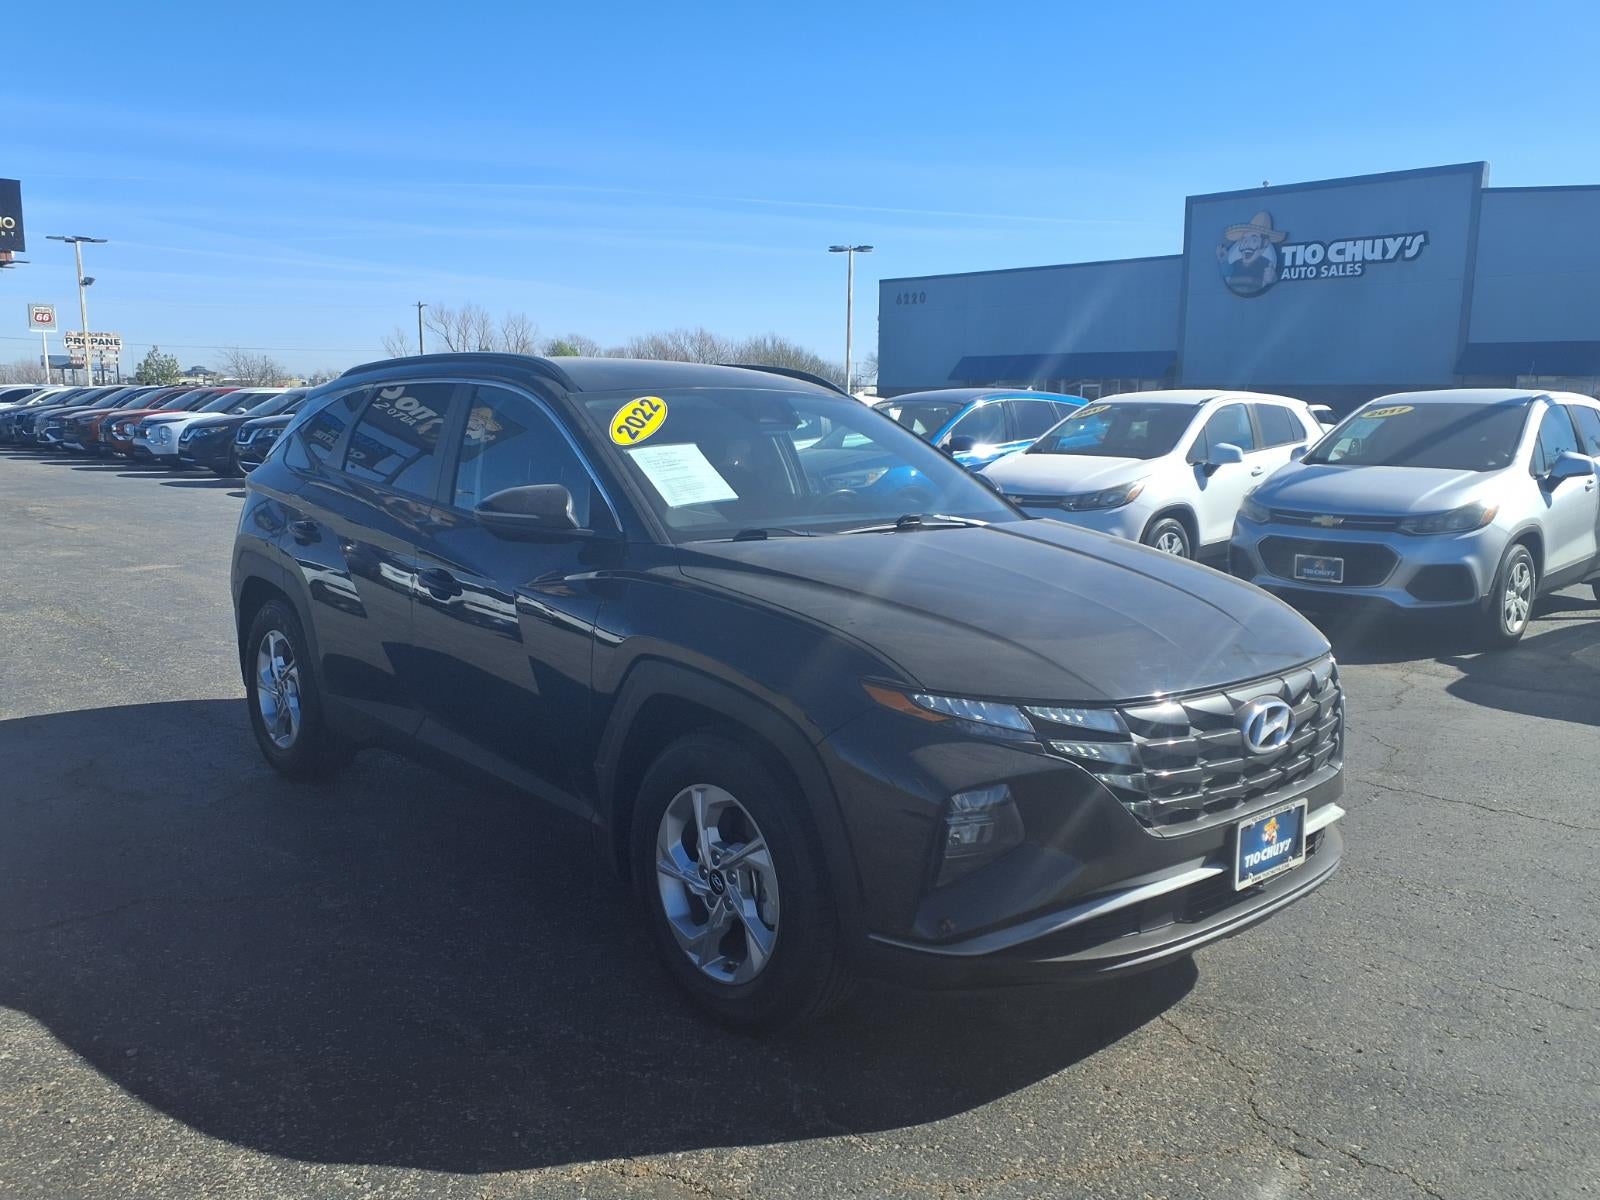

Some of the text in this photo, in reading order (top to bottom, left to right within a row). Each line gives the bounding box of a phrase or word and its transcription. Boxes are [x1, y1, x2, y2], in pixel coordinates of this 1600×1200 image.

[1281, 234, 1425, 267] TIO CHUY'S
[1281, 263, 1363, 280] AUTO SALES
[896, 291, 927, 306] 6220
[36, 313, 51, 322] 66
[65, 337, 121, 346] PROPANE
[616, 398, 661, 441] 2022
